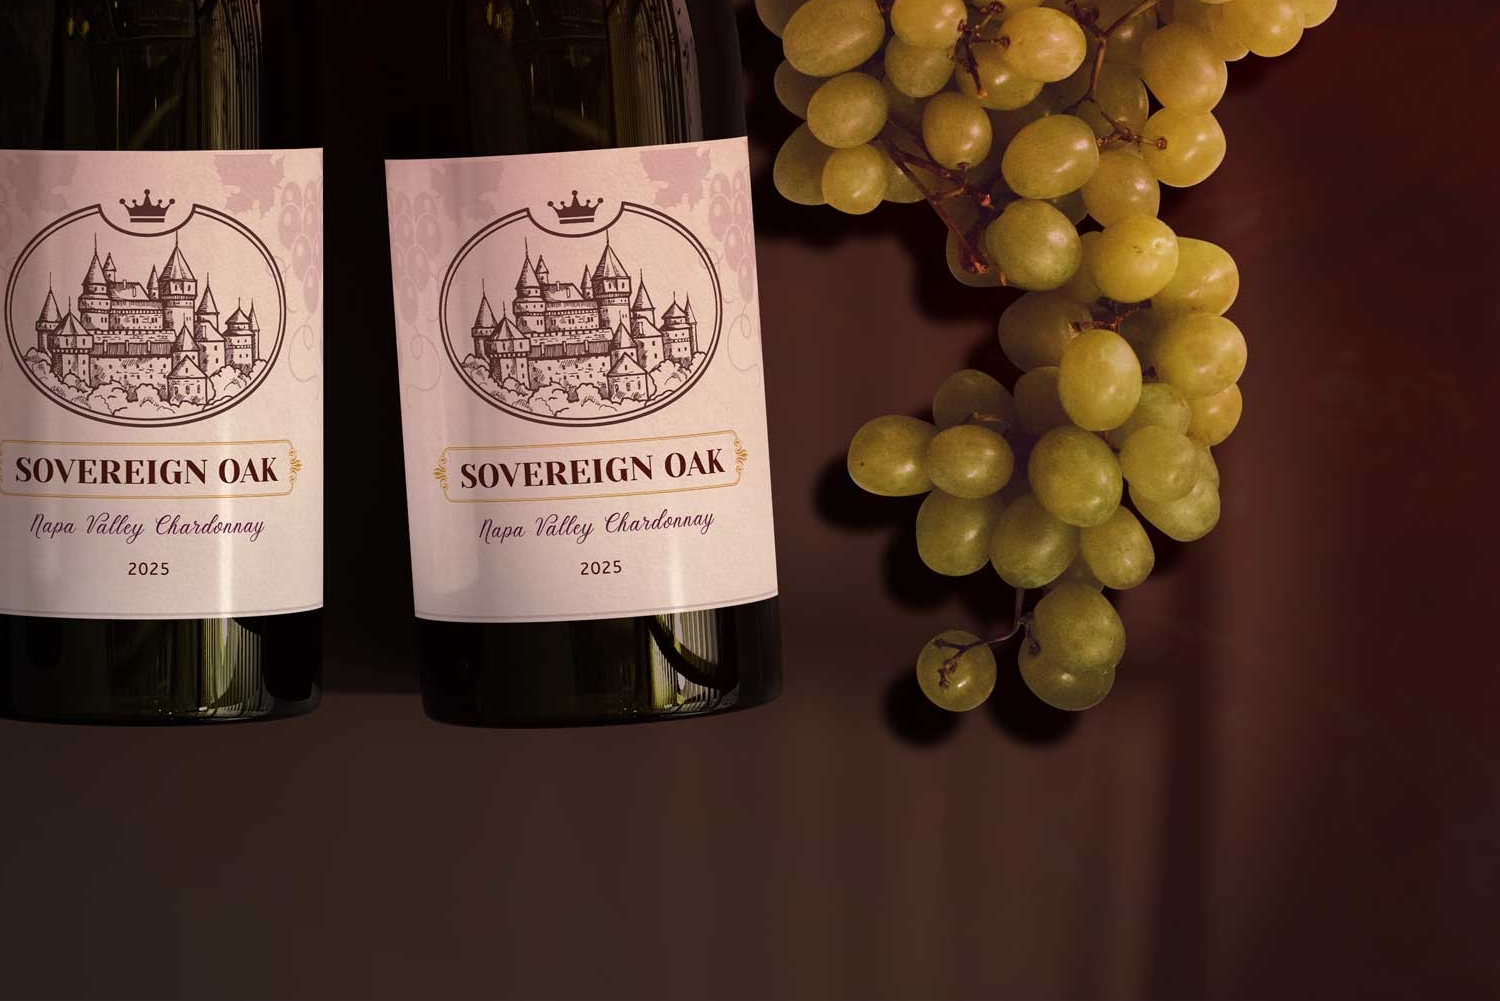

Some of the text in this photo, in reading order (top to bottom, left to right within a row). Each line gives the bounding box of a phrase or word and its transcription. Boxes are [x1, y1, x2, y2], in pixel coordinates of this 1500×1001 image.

[15, 456, 279, 485] SOVEREIGN OAK
[460, 448, 726, 489] SOVEREIGN OAK
[30, 512, 265, 544] Napa Valley Chardonnay
[478, 508, 715, 545] Napa Valley Chardonnay
[127, 562, 170, 576] 2025
[580, 560, 622, 576] 2025
